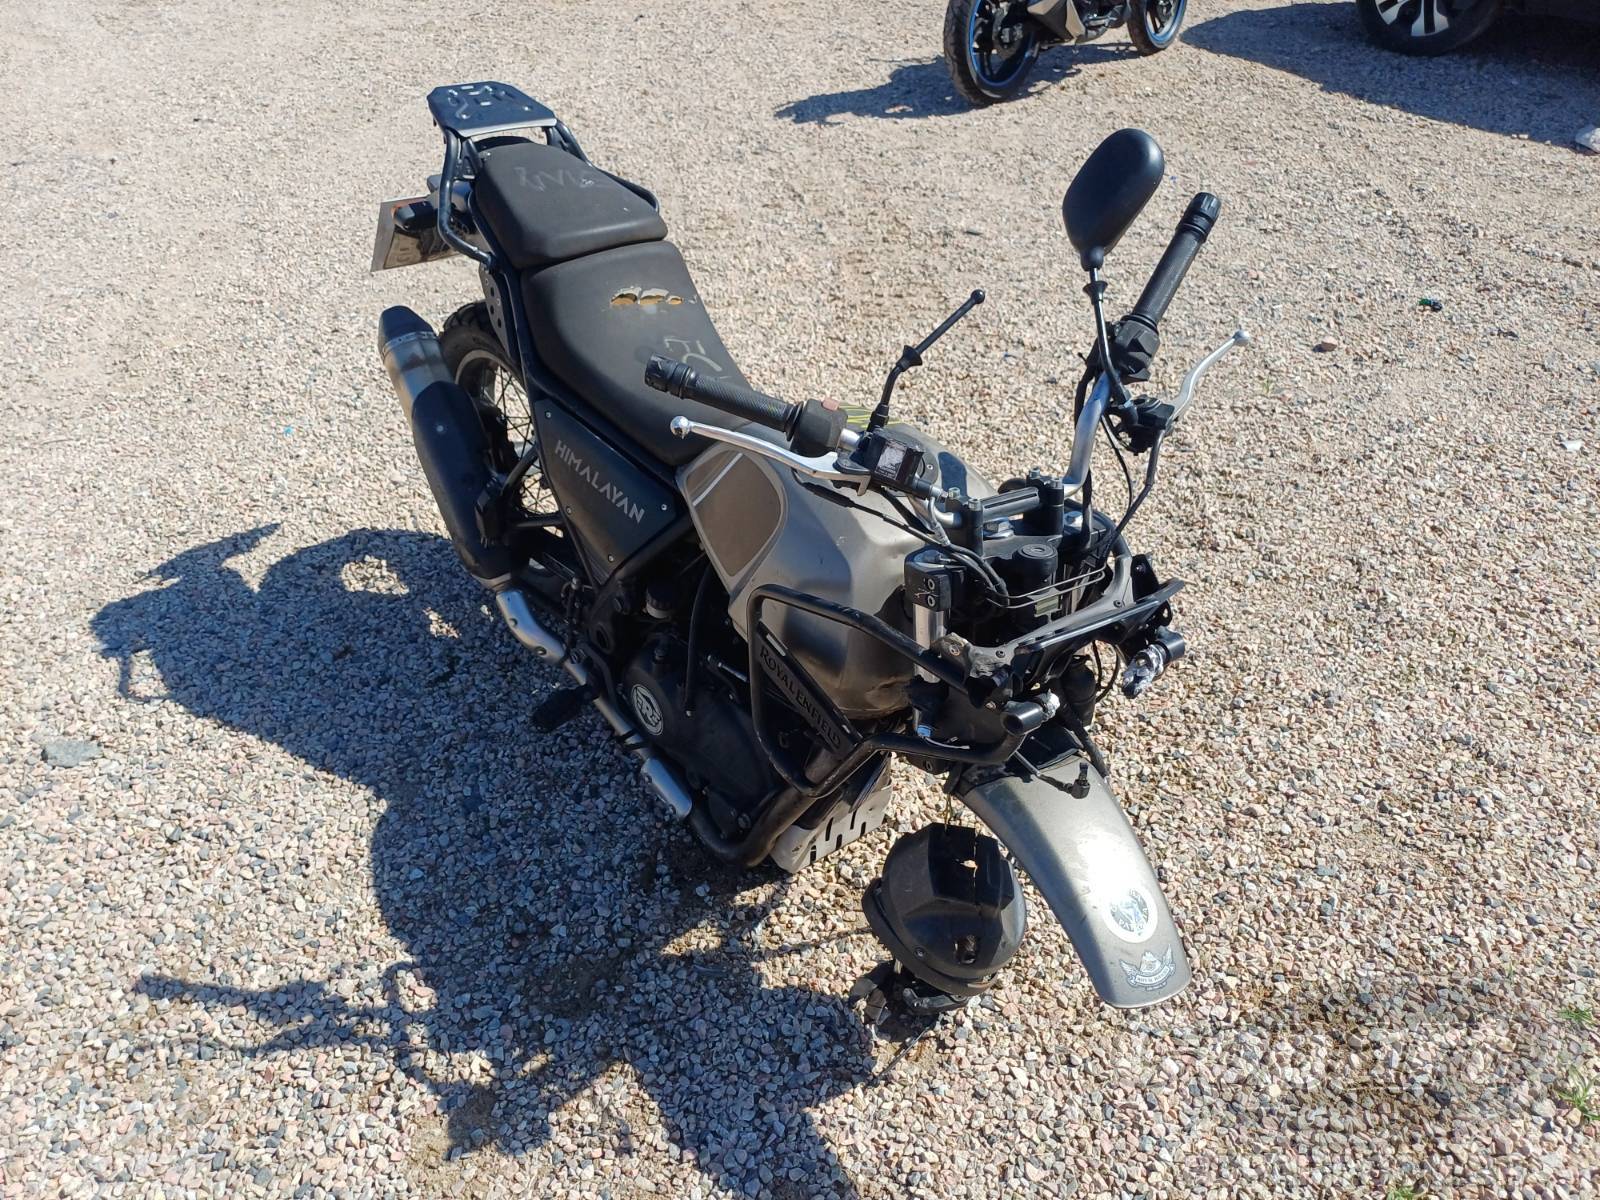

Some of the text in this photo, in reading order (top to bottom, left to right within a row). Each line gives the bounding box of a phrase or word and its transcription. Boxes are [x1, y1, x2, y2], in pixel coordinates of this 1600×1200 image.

[555, 440, 645, 523] HIMALAYAN
[760, 645, 841, 746] ROYAL ENFIELD
